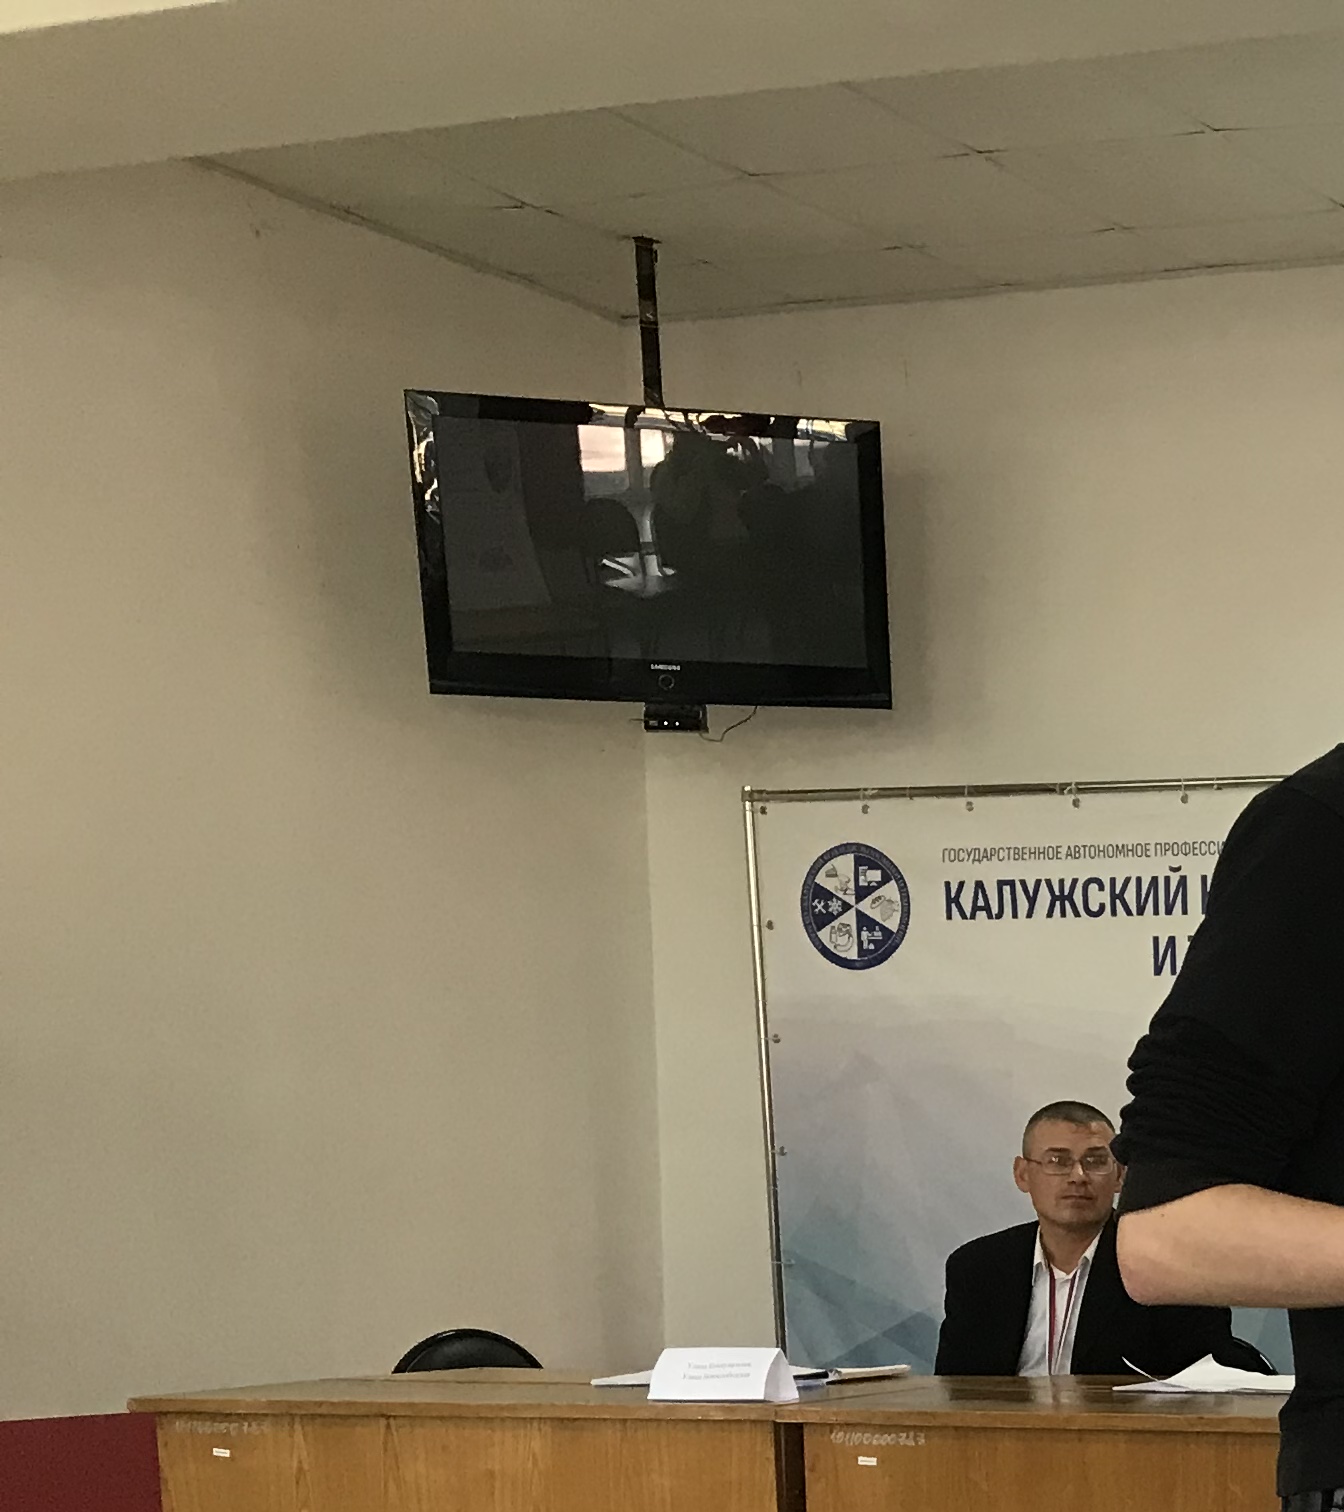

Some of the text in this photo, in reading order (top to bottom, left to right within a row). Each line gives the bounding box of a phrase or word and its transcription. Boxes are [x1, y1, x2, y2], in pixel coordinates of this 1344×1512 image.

[942, 845, 1063, 865] ГОСУДАРСТВЕННОЕ
[1065, 842, 1151, 860] АВТОНОМНОЕ
[943, 865, 1189, 921] КАЛУЖСКИЙ
[1152, 935, 1178, 976] И
